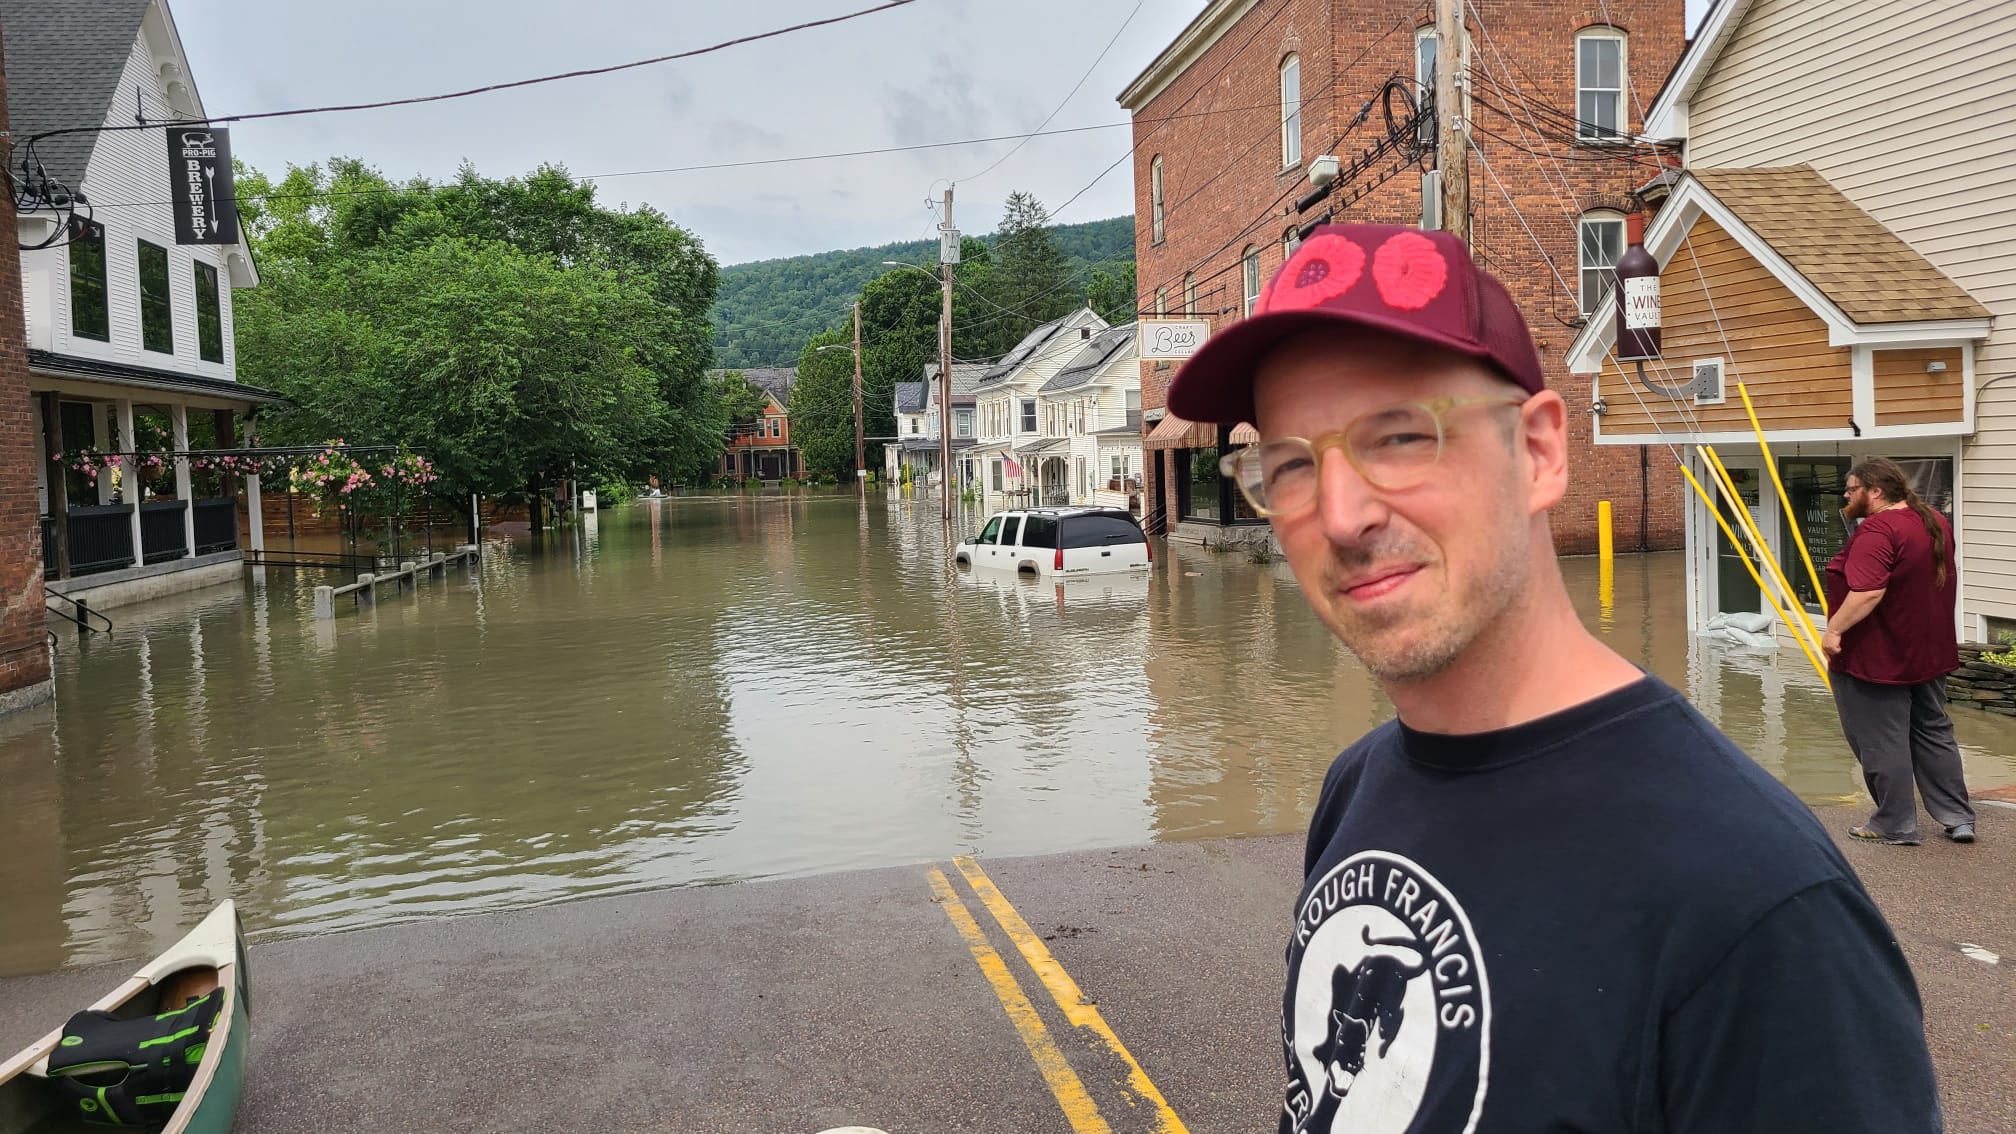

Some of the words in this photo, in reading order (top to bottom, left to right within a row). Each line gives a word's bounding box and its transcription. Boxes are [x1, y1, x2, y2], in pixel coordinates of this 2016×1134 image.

[187, 160, 207, 239] BREWERY
[1632, 295, 1660, 310] WINE
[1151, 326, 1196, 352] Beer
[1806, 509, 1829, 523] WINE
[1807, 527, 1828, 535] VAULT
[1296, 863, 1375, 947] ROUGH
[1384, 867, 1476, 1029] FRANCIS
